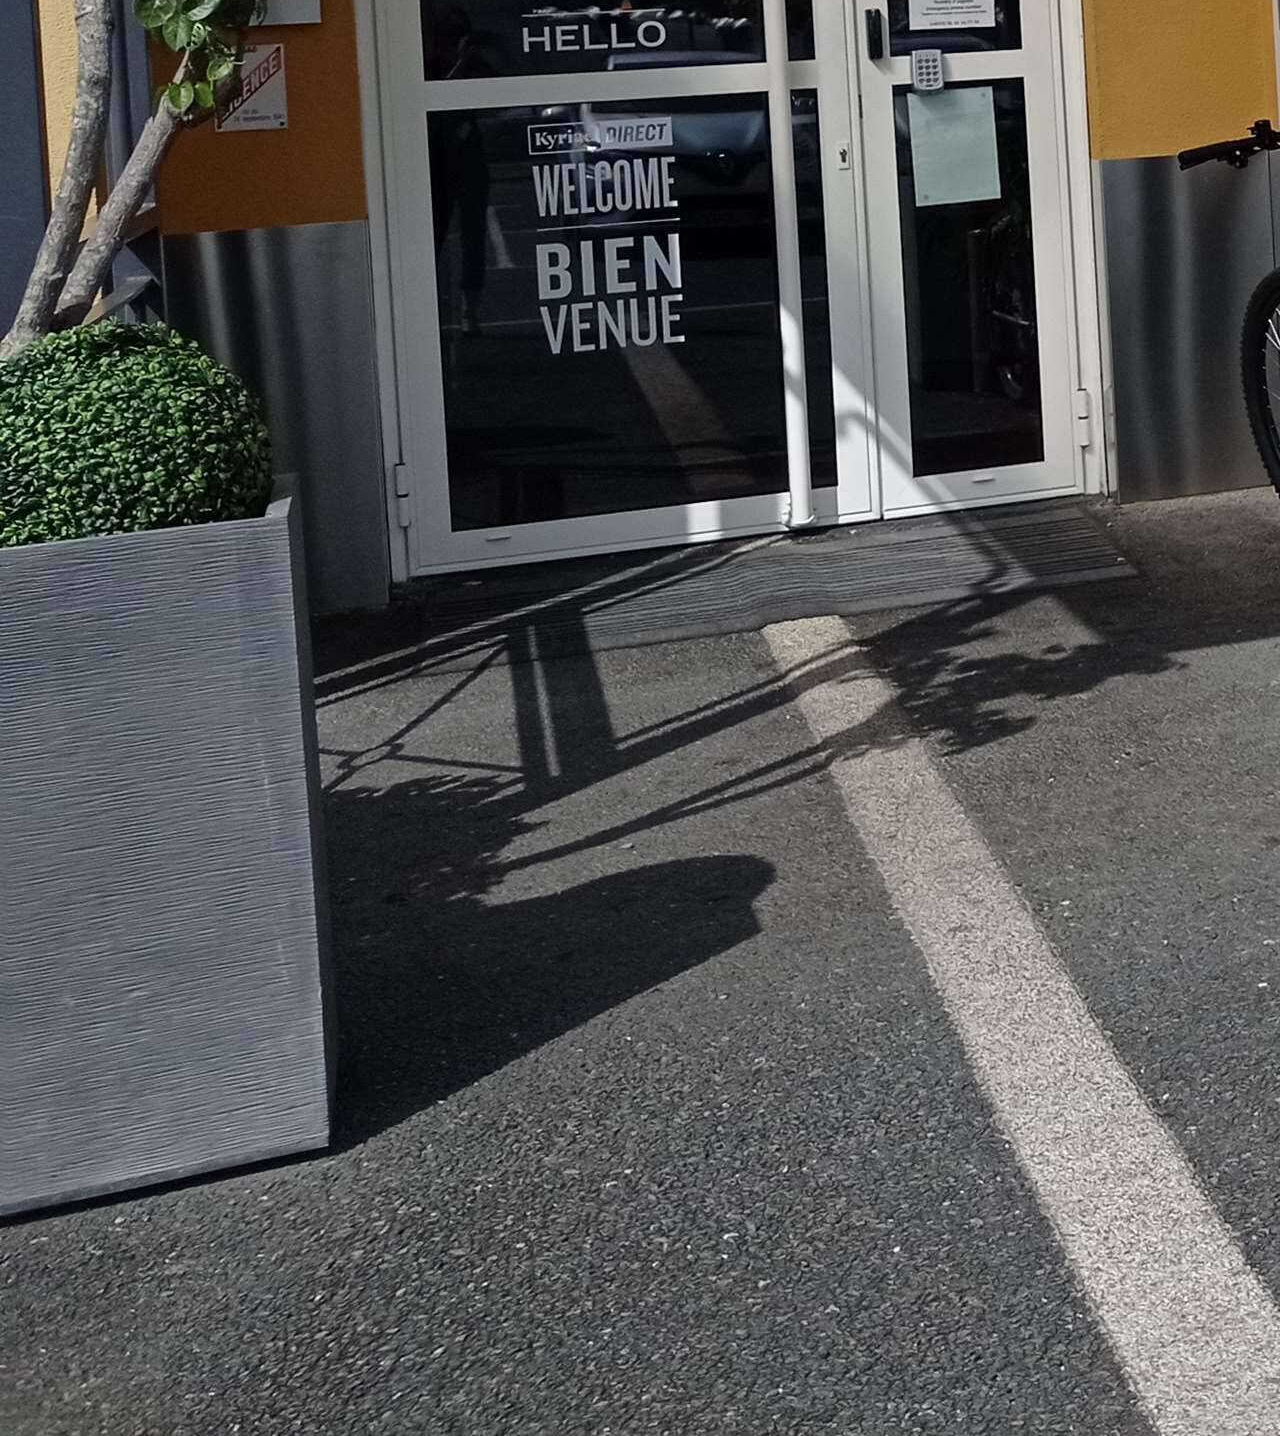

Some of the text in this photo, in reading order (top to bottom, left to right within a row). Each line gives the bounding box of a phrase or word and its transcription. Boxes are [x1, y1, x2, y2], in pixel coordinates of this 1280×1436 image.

[521, 20, 667, 53] HELLO
[606, 123, 667, 143] DIRECT
[532, 156, 679, 218] WELCOME
[536, 233, 683, 301] BIEN
[540, 293, 686, 355] VENUE
